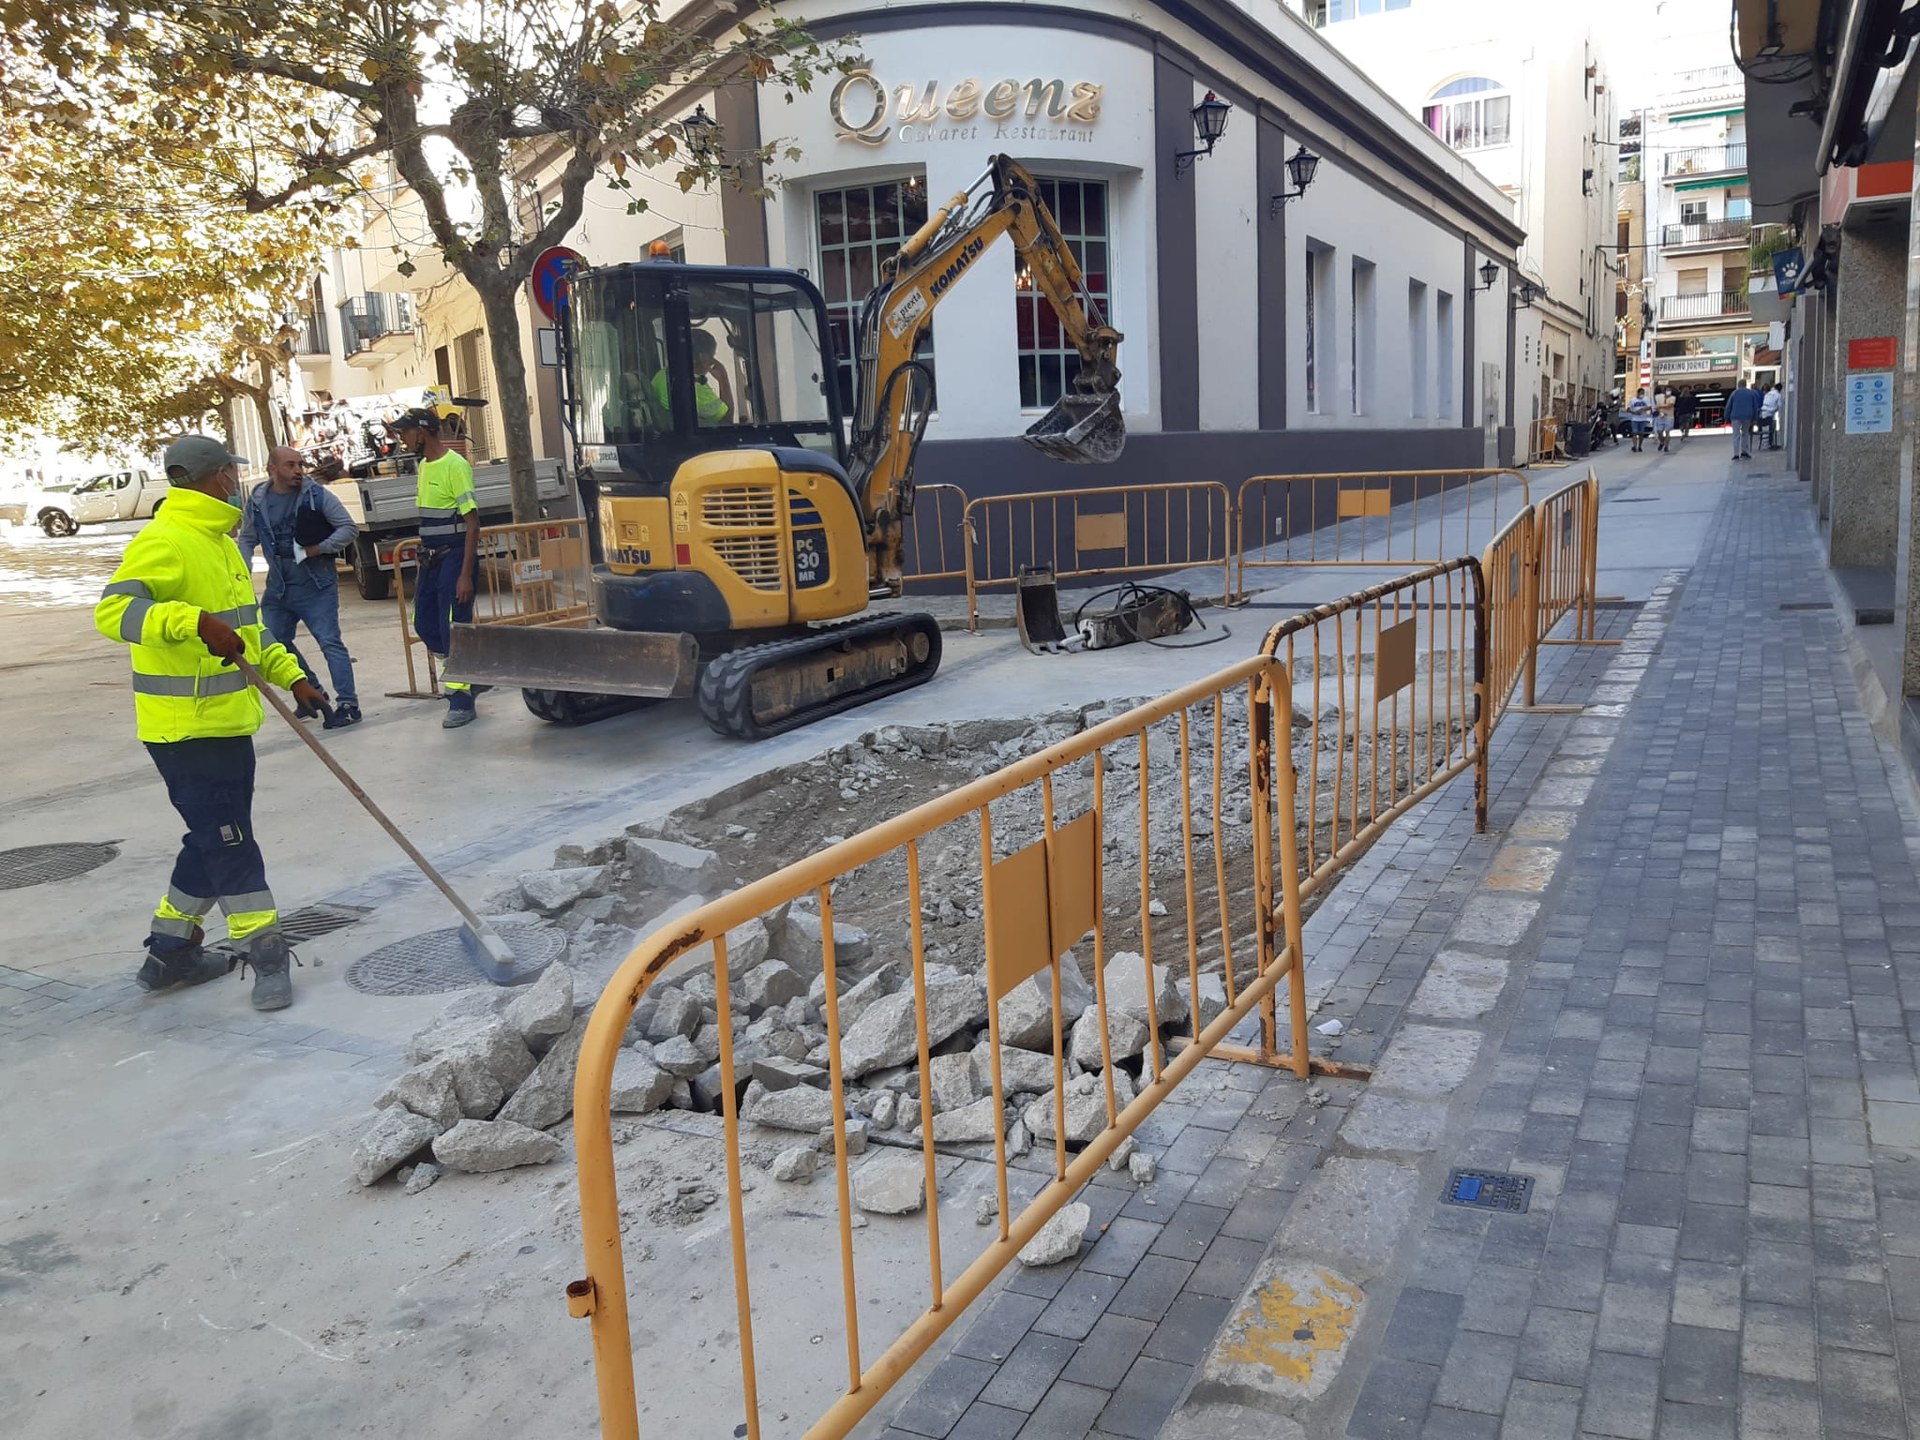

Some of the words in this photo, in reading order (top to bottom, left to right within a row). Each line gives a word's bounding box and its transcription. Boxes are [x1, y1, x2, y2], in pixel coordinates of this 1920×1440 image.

[929, 236, 985, 299] KOMATSU
[900, 292, 922, 319] prexta
[1659, 362, 1685, 373] PARKING
[796, 538, 813, 552] PC
[797, 552, 820, 569] 30
[798, 571, 816, 582] MR
